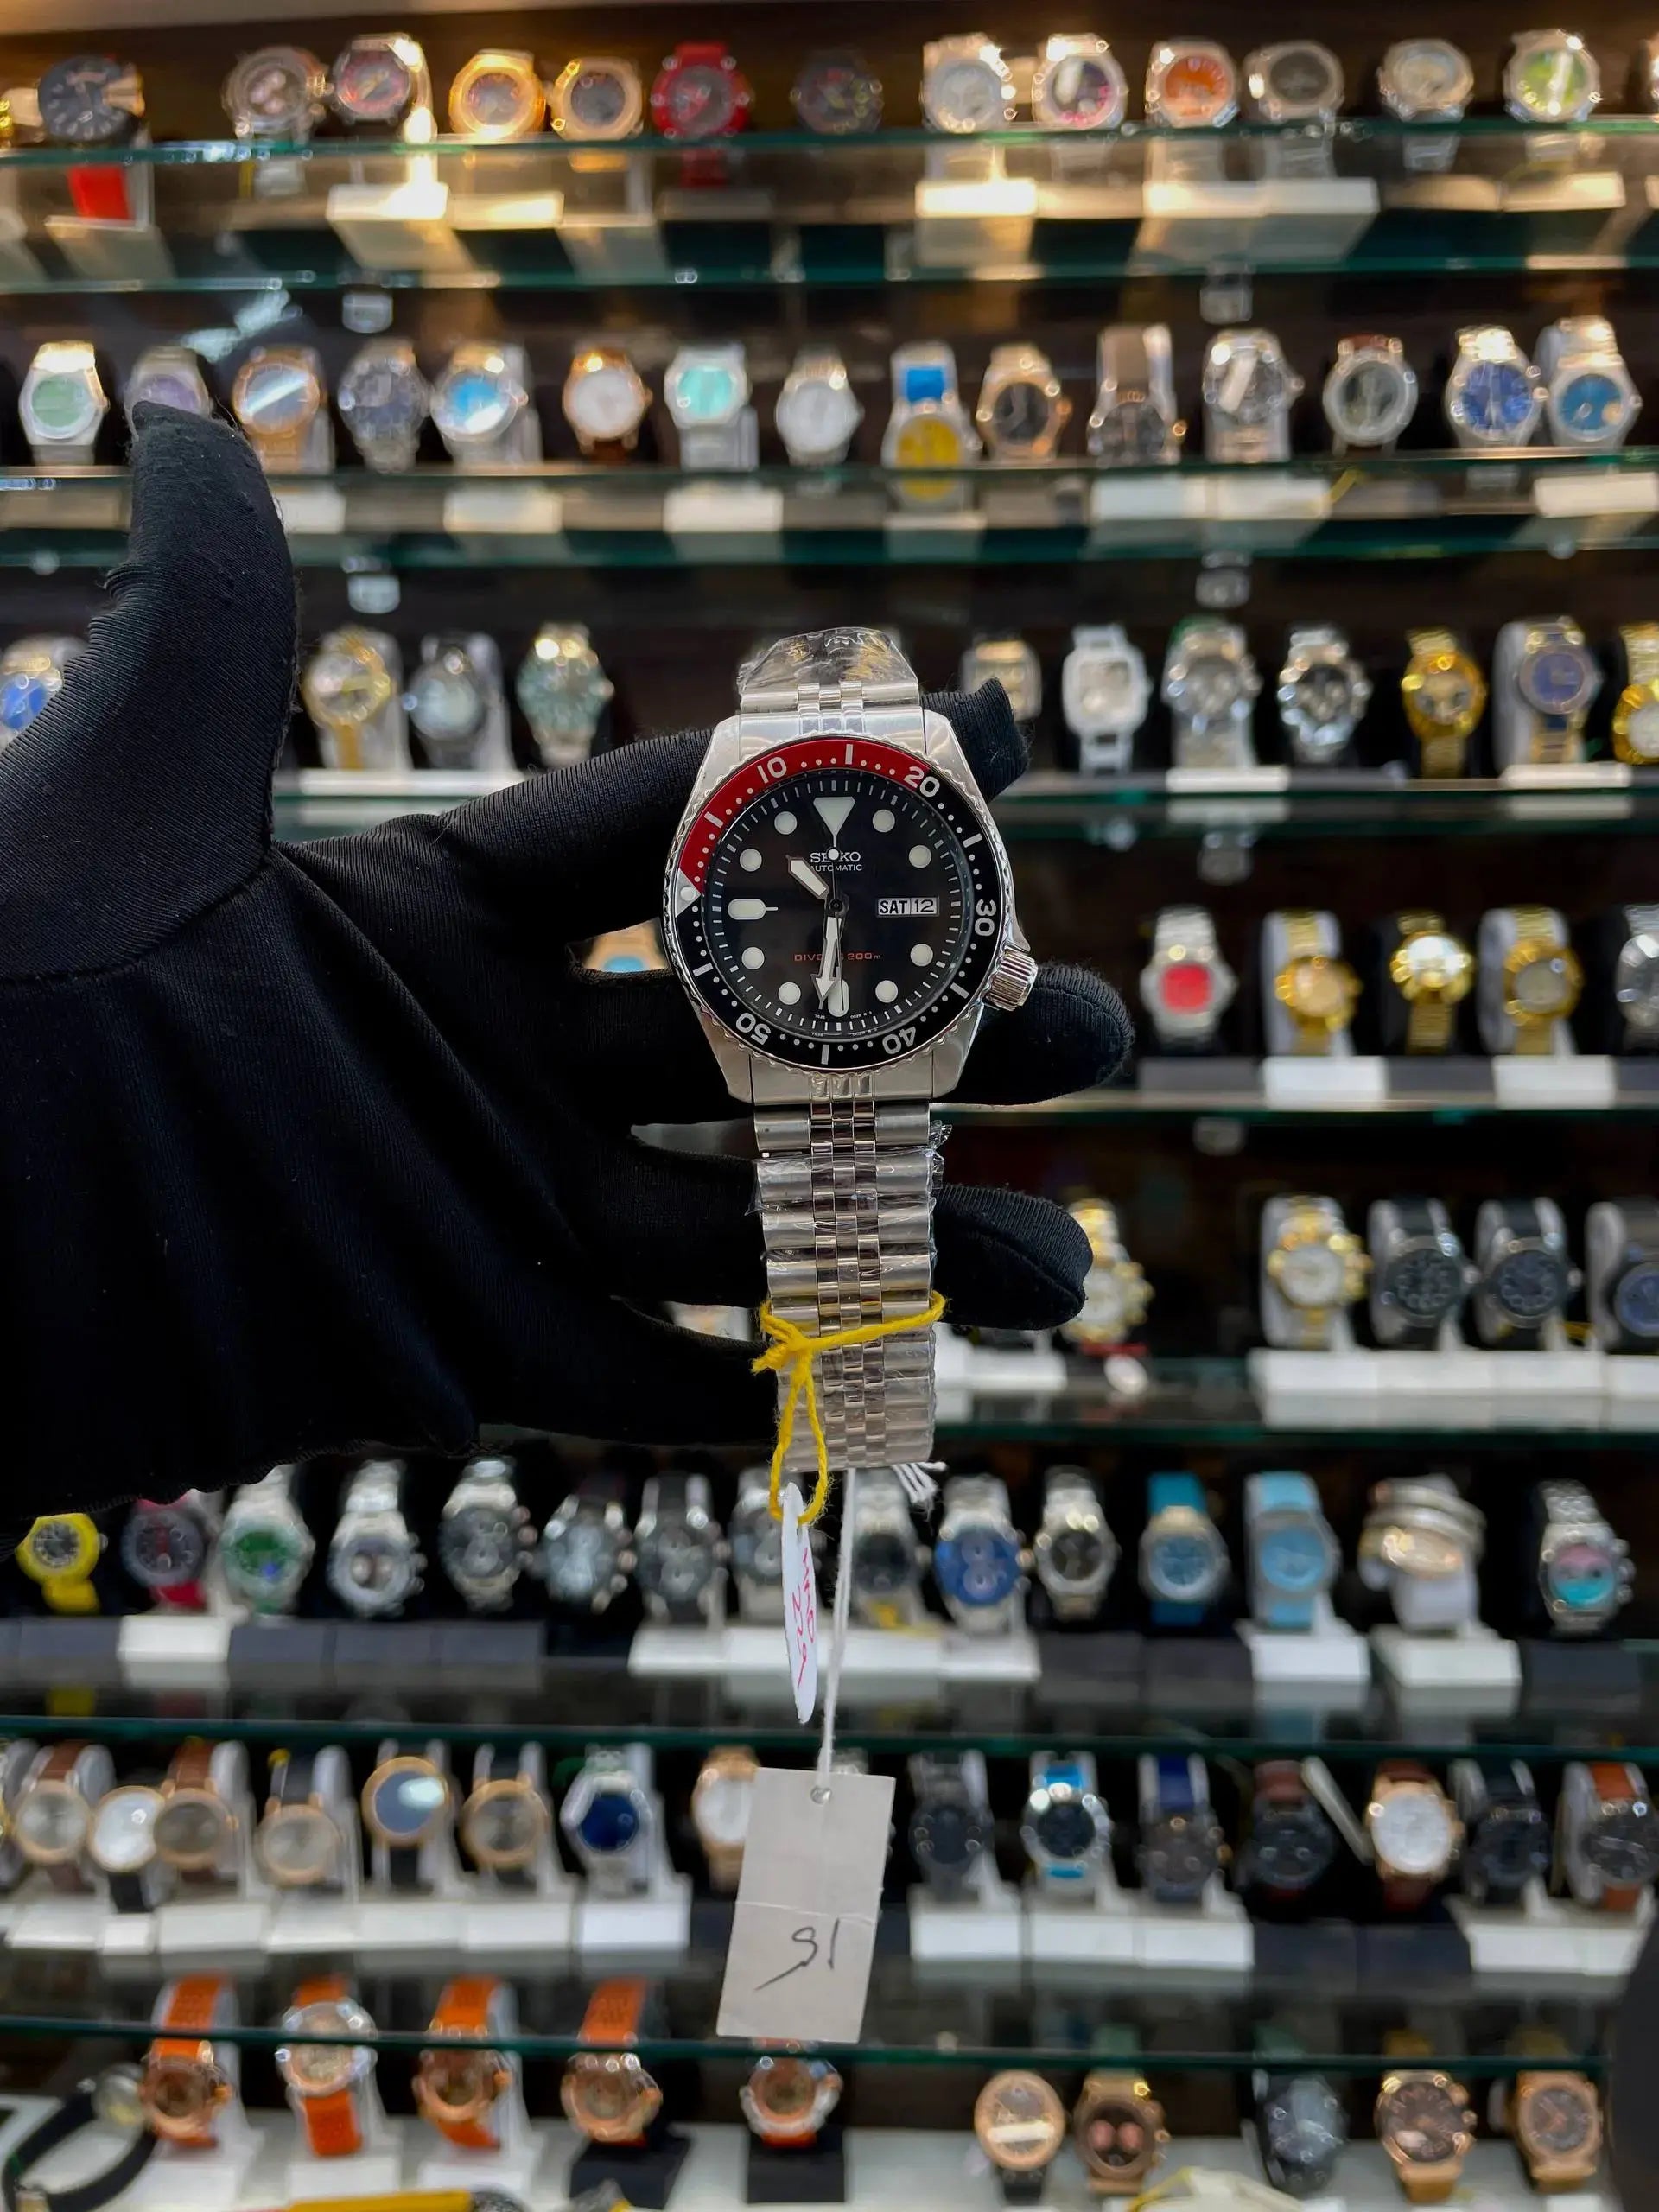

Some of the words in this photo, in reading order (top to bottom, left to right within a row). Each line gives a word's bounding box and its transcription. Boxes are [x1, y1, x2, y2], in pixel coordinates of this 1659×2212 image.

[758, 757, 788, 784] 10
[904, 766, 941, 798] 20
[810, 851, 861, 863] SEKO
[880, 899, 908, 914] SAT
[914, 899, 935, 913] 12
[975, 899, 997, 937] 30
[736, 1011, 772, 1046] 50
[881, 1026, 917, 1055] 40
